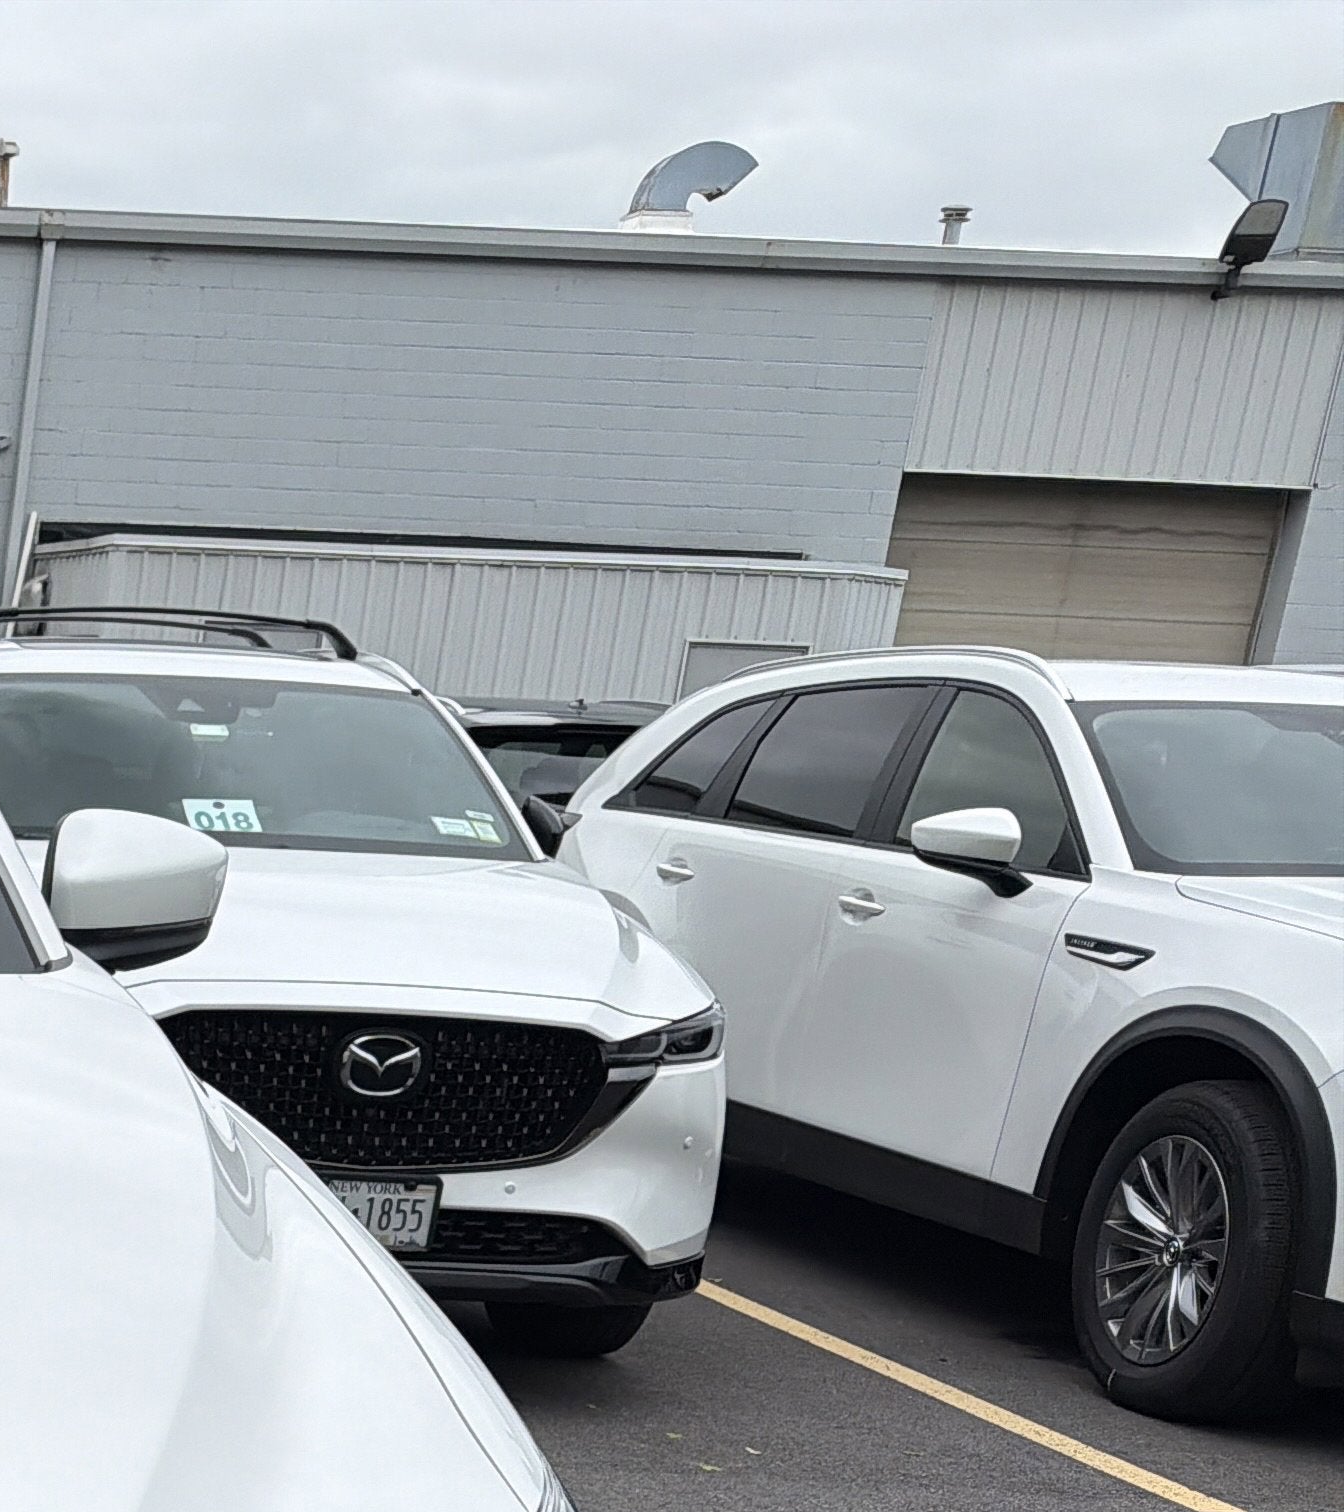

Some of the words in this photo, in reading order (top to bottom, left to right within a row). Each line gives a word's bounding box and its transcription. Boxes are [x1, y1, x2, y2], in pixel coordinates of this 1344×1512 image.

[194, 811, 254, 831] 018
[329, 1181, 362, 1193] NEW
[365, 1182, 402, 1195] YORK
[364, 1197, 426, 1232] 1855
